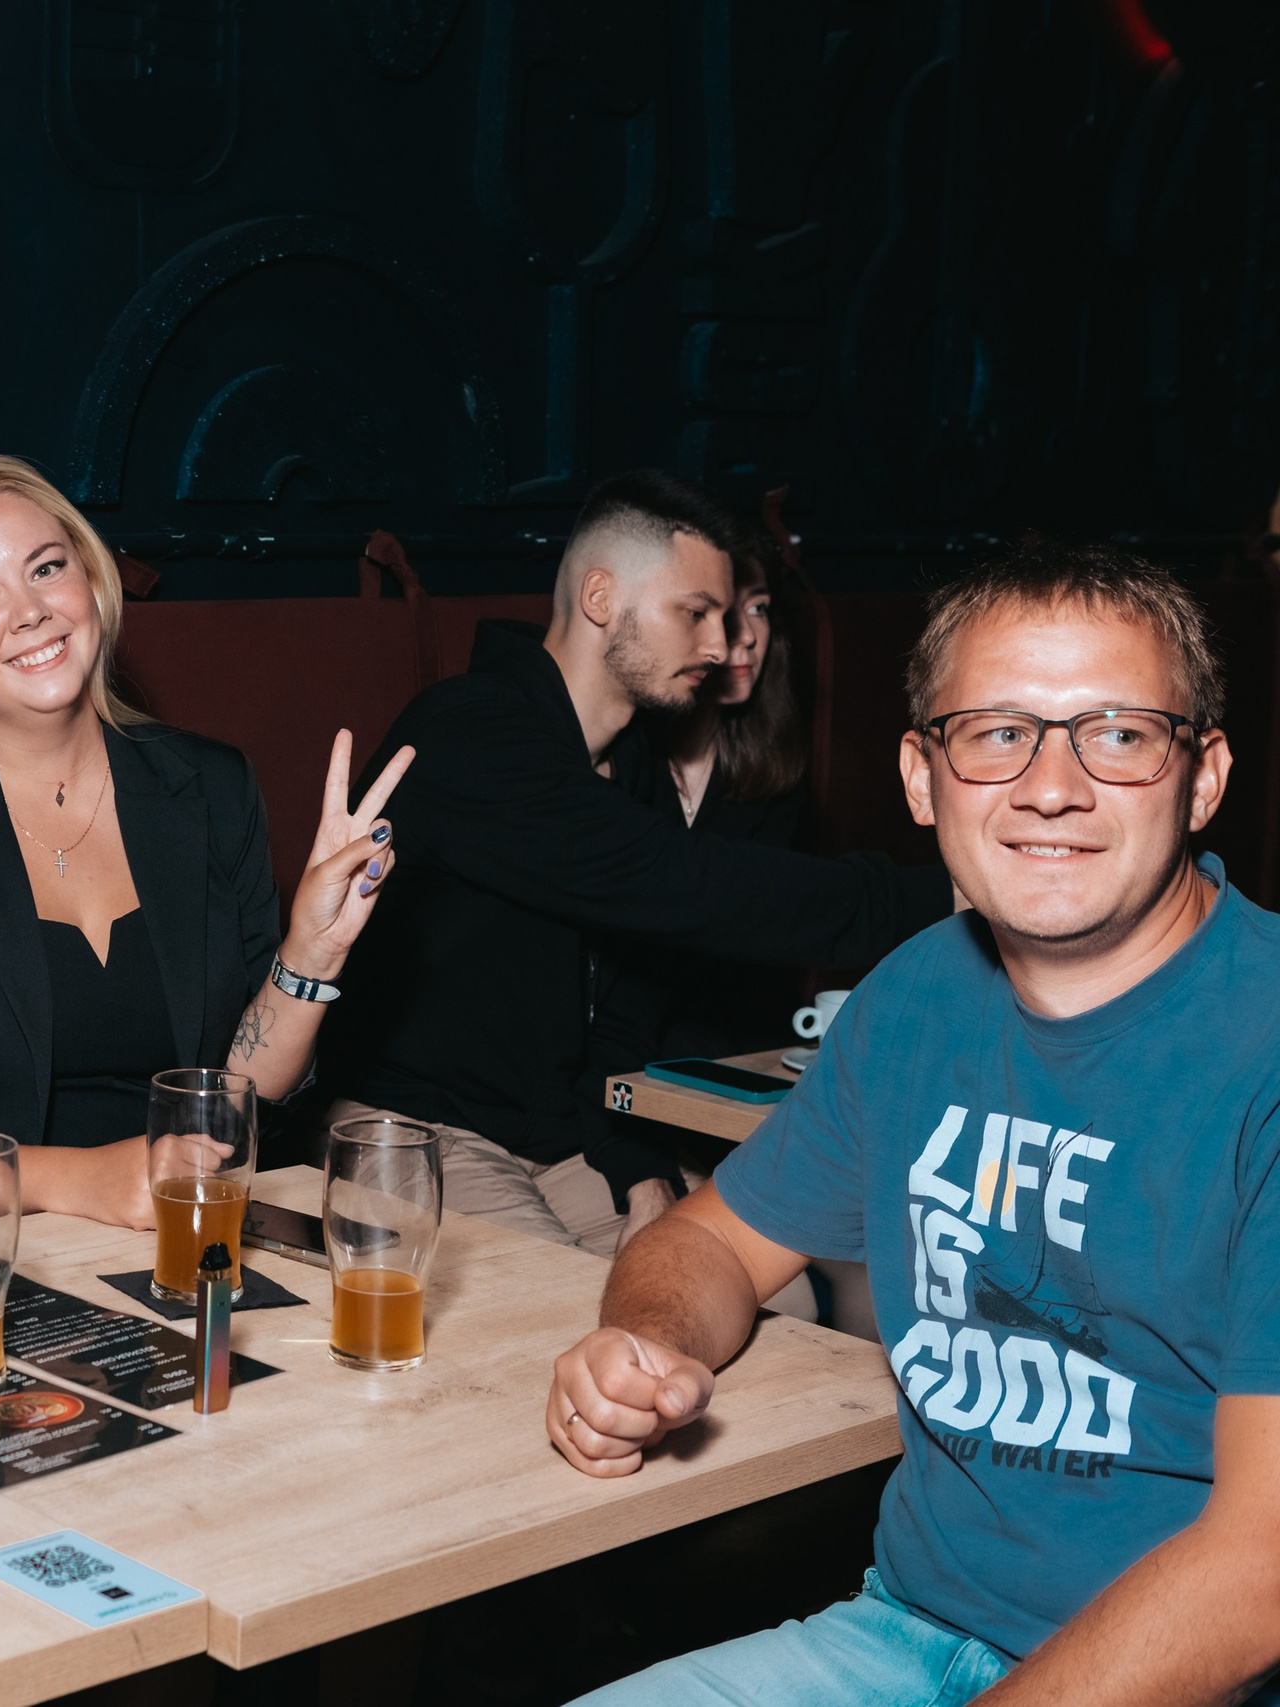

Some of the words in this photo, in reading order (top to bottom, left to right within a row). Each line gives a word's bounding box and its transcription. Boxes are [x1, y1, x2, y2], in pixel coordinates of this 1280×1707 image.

[909, 1105, 1116, 1252] LIFE
[909, 1203, 986, 1320] IS
[891, 1319, 1137, 1455] GOOD
[932, 1432, 981, 1462] DD
[991, 1440, 1115, 1479] WATER
